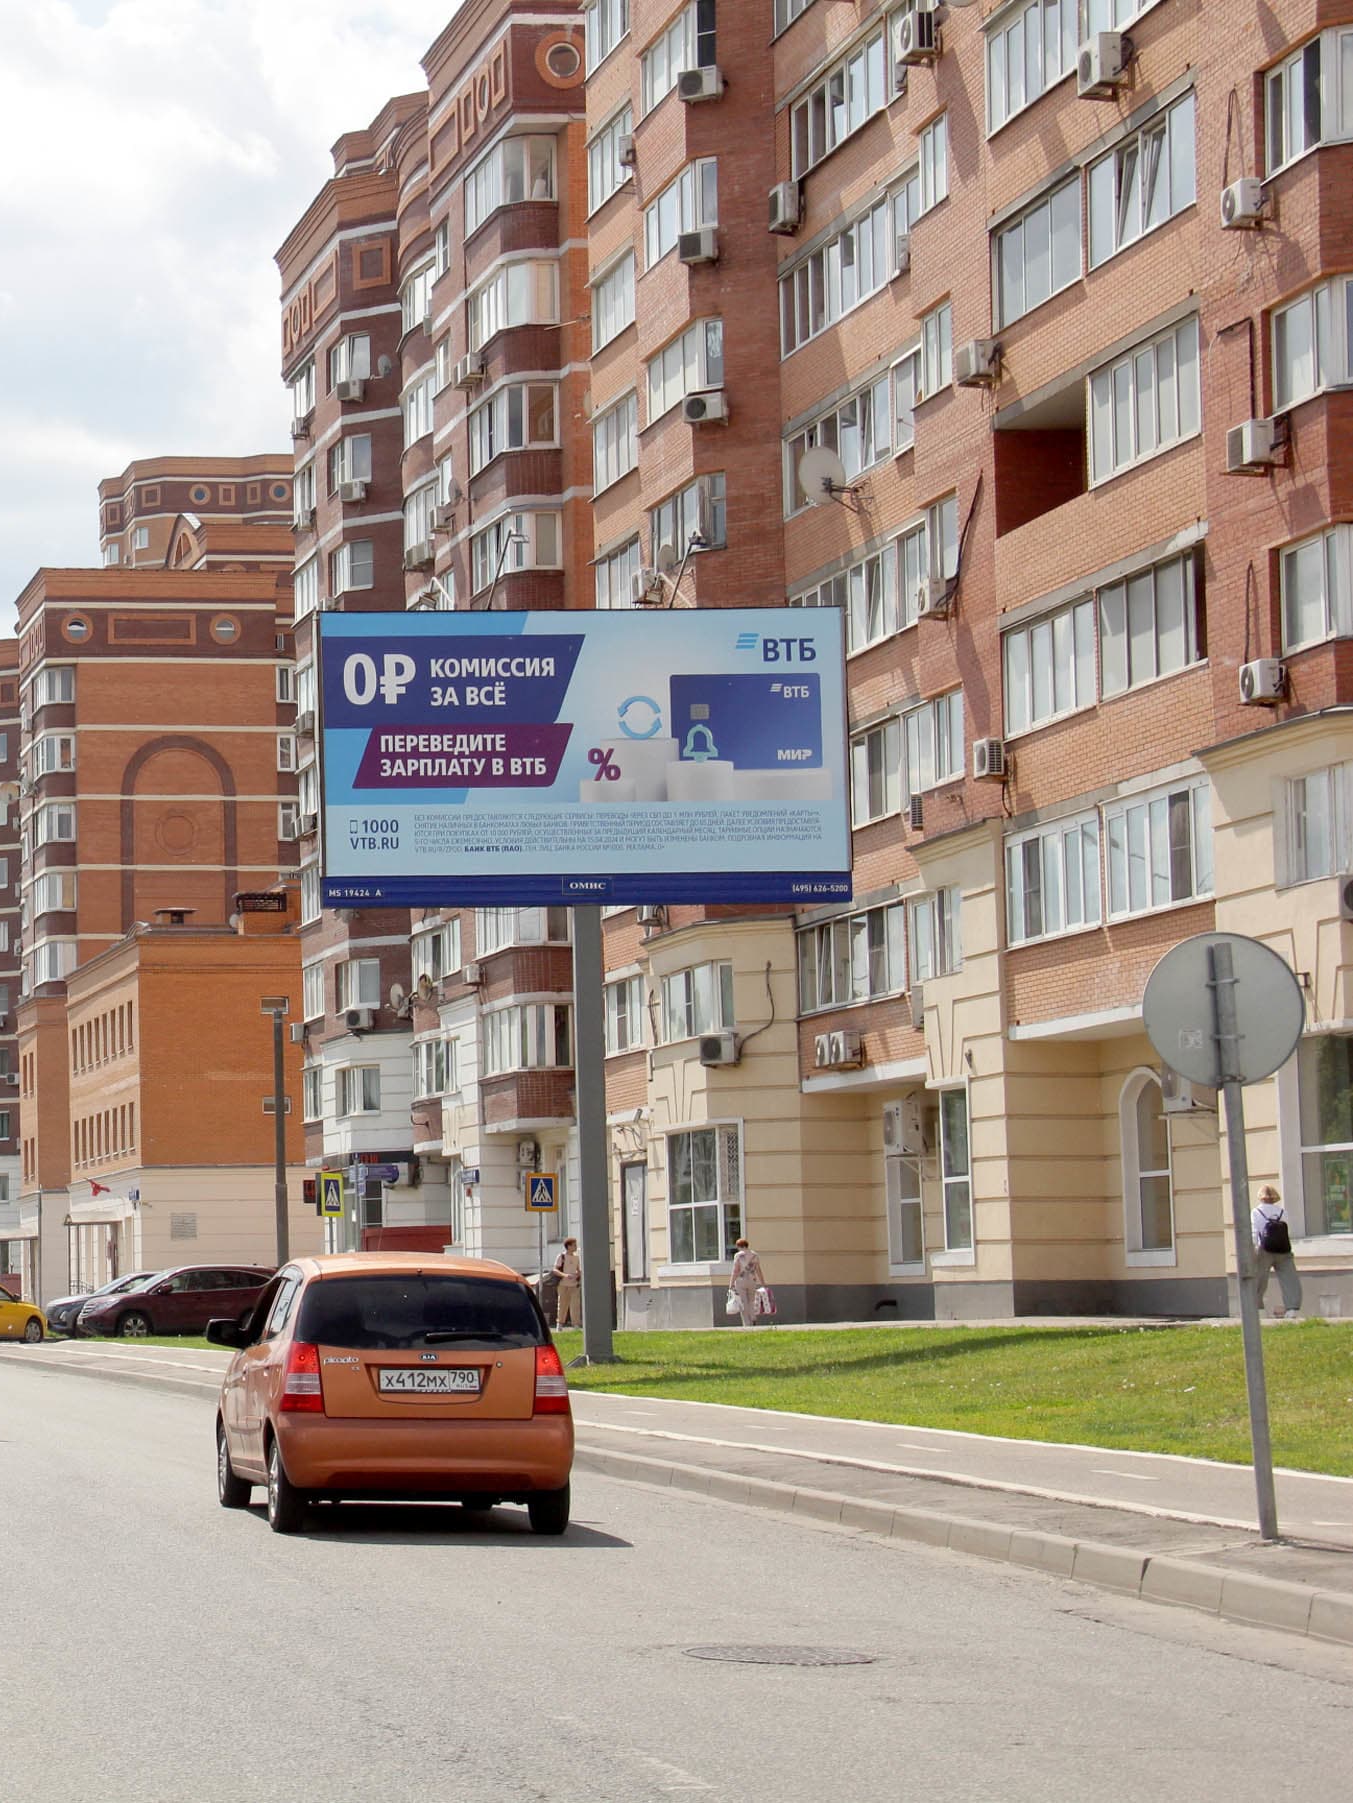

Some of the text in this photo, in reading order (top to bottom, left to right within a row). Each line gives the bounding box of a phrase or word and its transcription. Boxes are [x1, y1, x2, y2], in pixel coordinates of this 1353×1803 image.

[762, 637, 817, 662] ВТБ
[430, 657, 555, 678] КОМИССИЯ
[430, 682, 506, 706] ЗА ВСЁ
[783, 685, 810, 698] ВТБ
[380, 733, 506, 755] ПЕРЕВЕДИТЕ
[777, 749, 813, 760] МИР
[380, 757, 547, 776] ЗАРПЛАТУ В ВТБ
[362, 819, 399, 833] 1000
[350, 837, 399, 849] VTB.RU
[451, 1371, 474, 1383] 790
